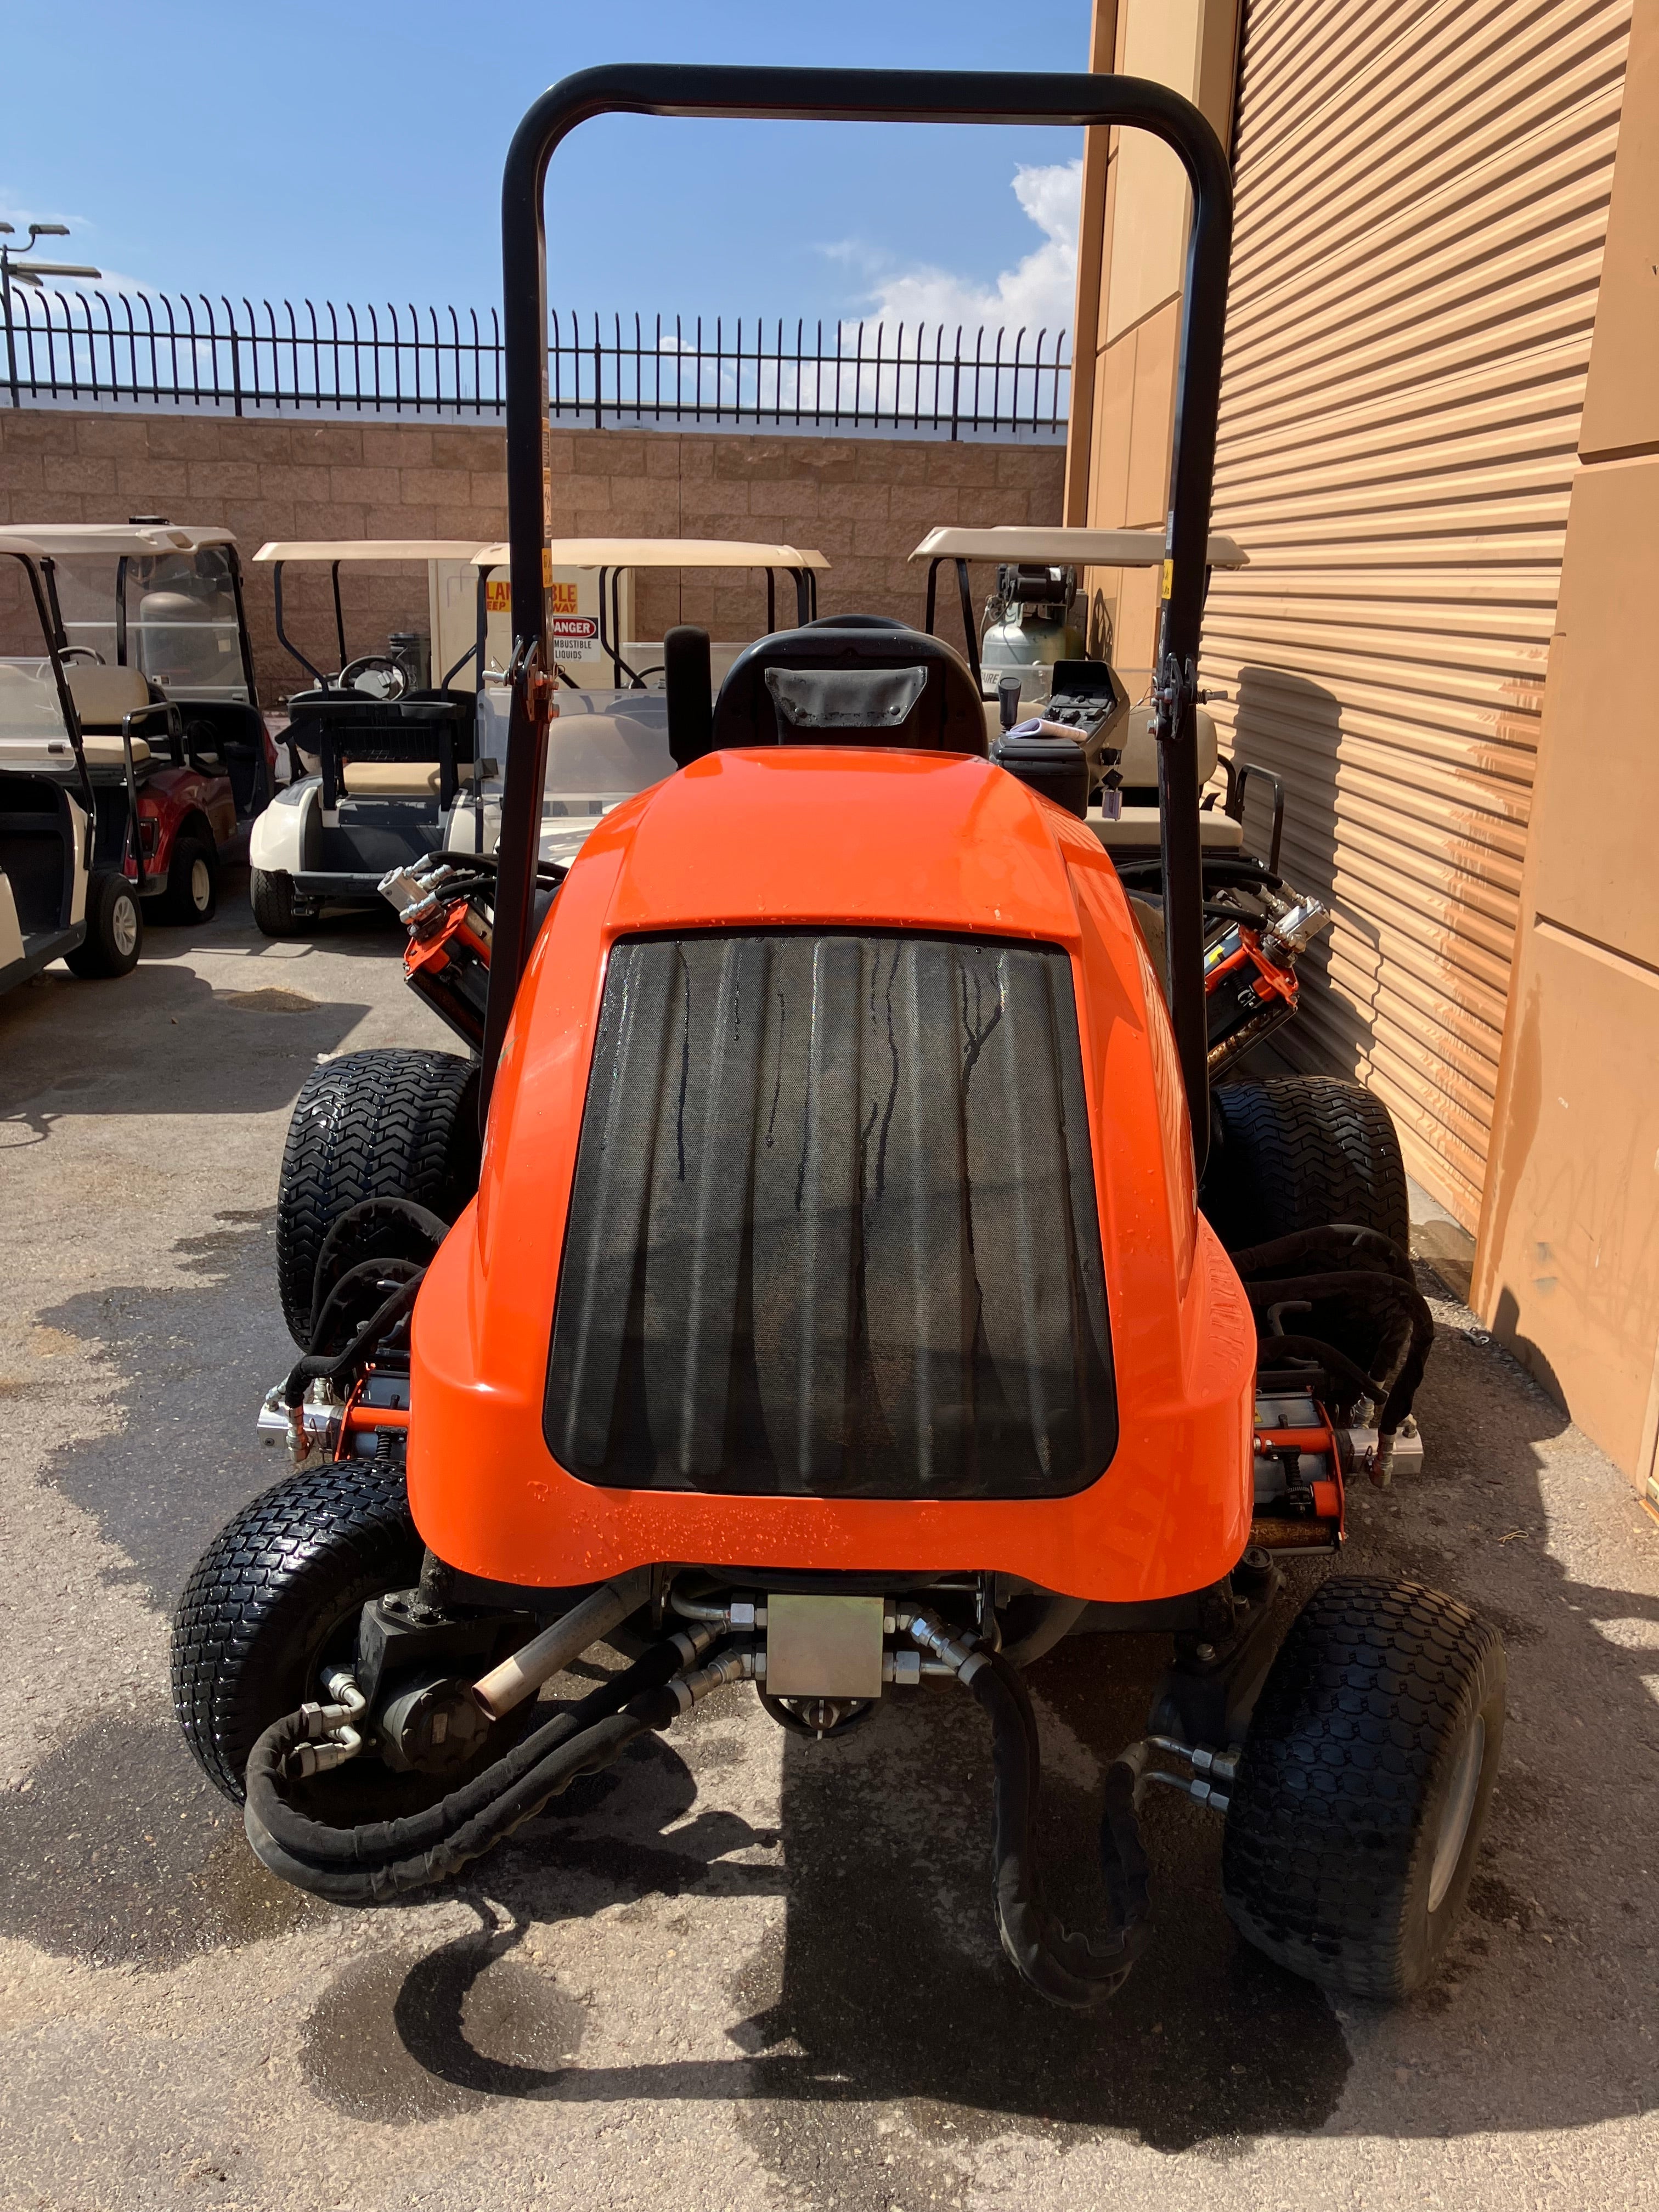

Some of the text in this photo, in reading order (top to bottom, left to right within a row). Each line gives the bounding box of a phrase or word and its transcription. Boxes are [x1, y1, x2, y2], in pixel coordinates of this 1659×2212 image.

[486, 601, 576, 613] EEP WAY
[554, 622, 590, 633] ANGER
[554, 640, 591, 648] MBUSTIBLE
[555, 650, 582, 659] LIQUIDS
[982, 673, 1000, 684] AIRE
